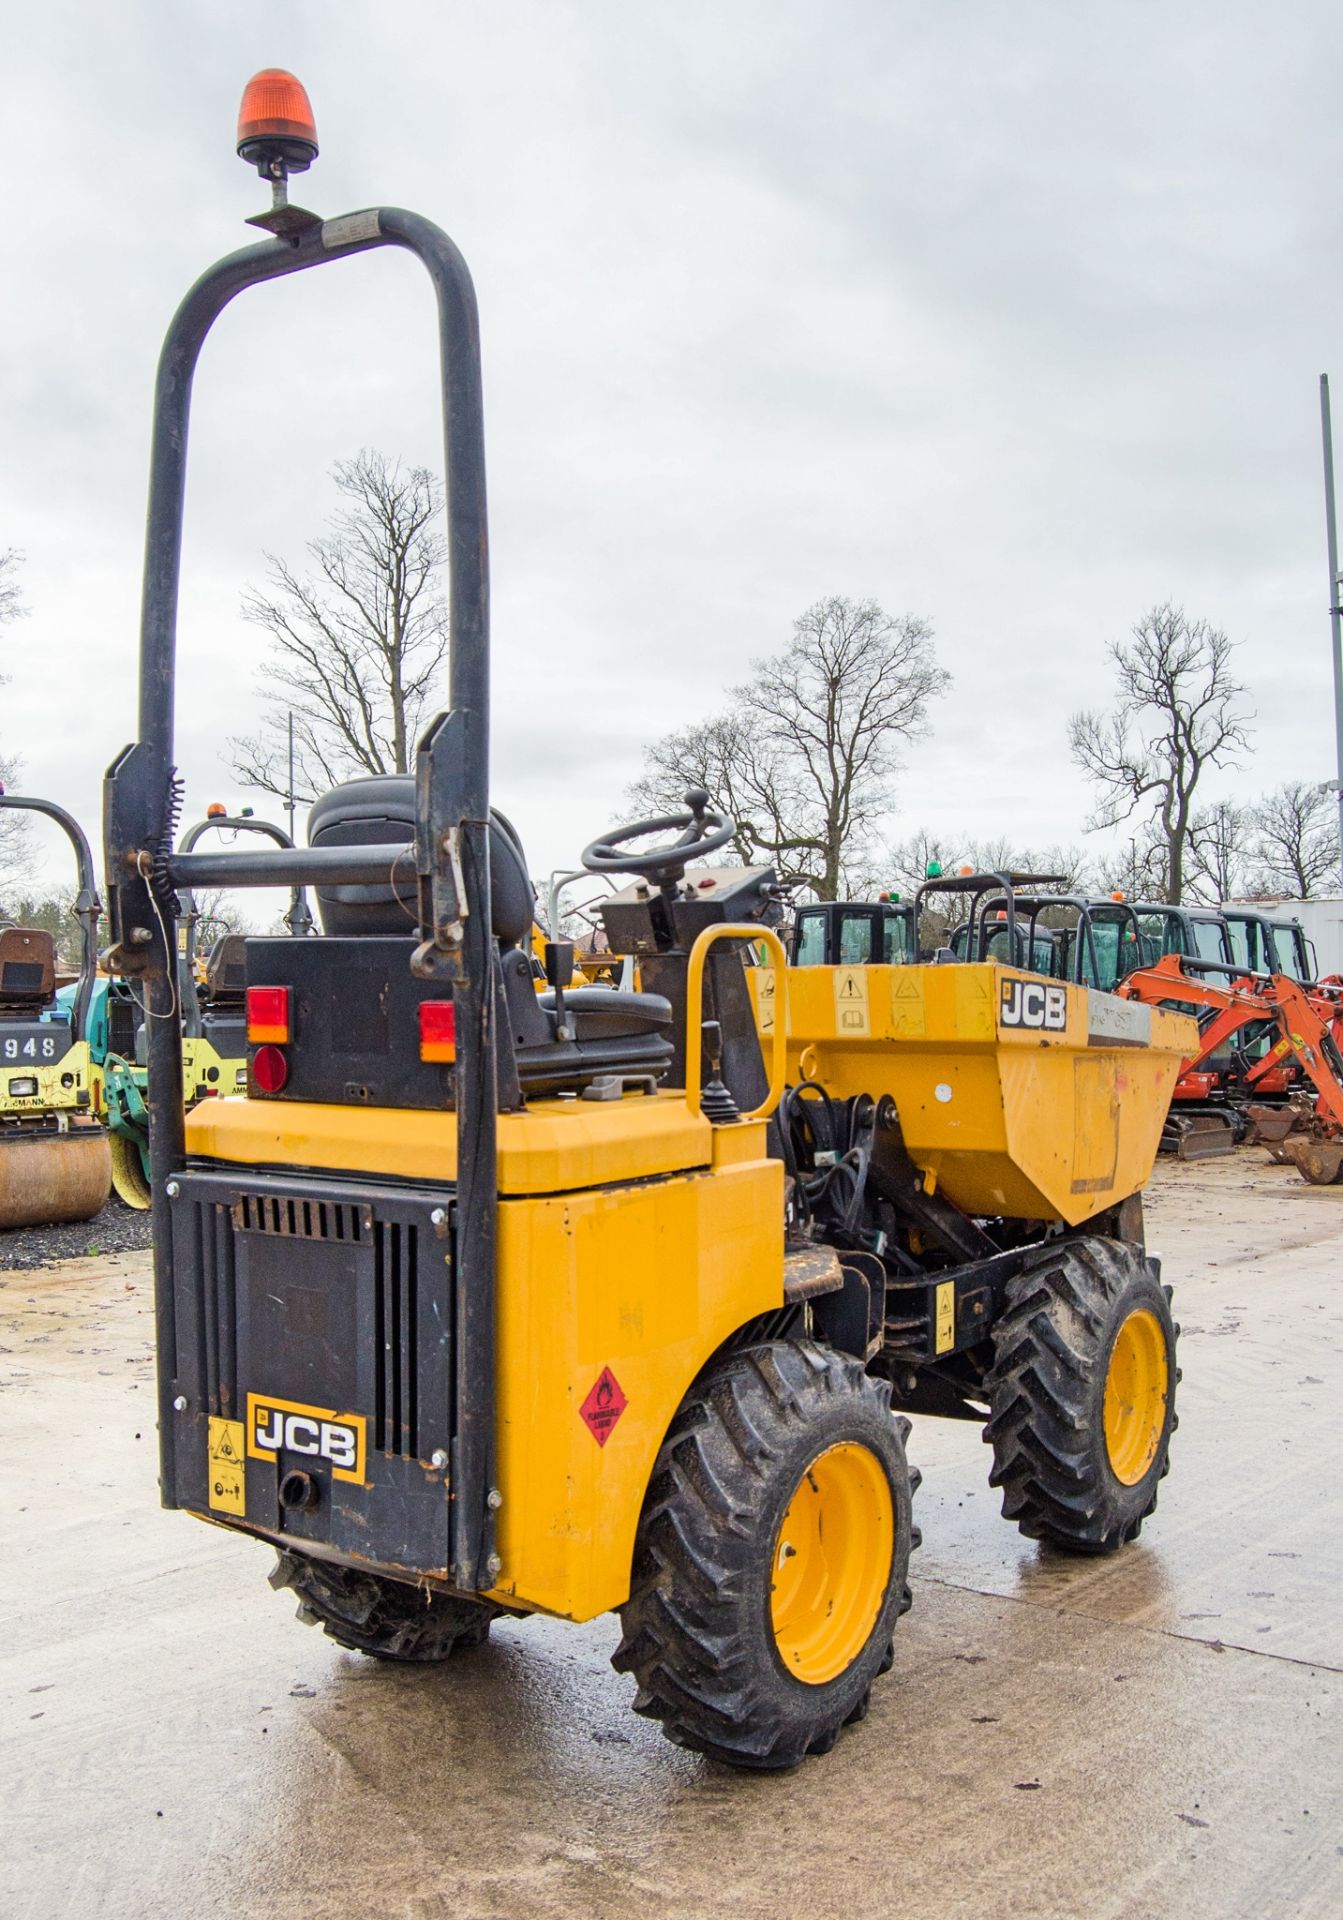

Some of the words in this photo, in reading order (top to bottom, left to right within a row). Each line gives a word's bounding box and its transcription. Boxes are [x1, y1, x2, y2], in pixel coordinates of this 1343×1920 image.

[1002, 982, 1065, 1028] JCB
[5, 1037, 55, 1058] 948
[4, 1098, 45, 1108] MANN
[256, 1412, 356, 1467] JCB
